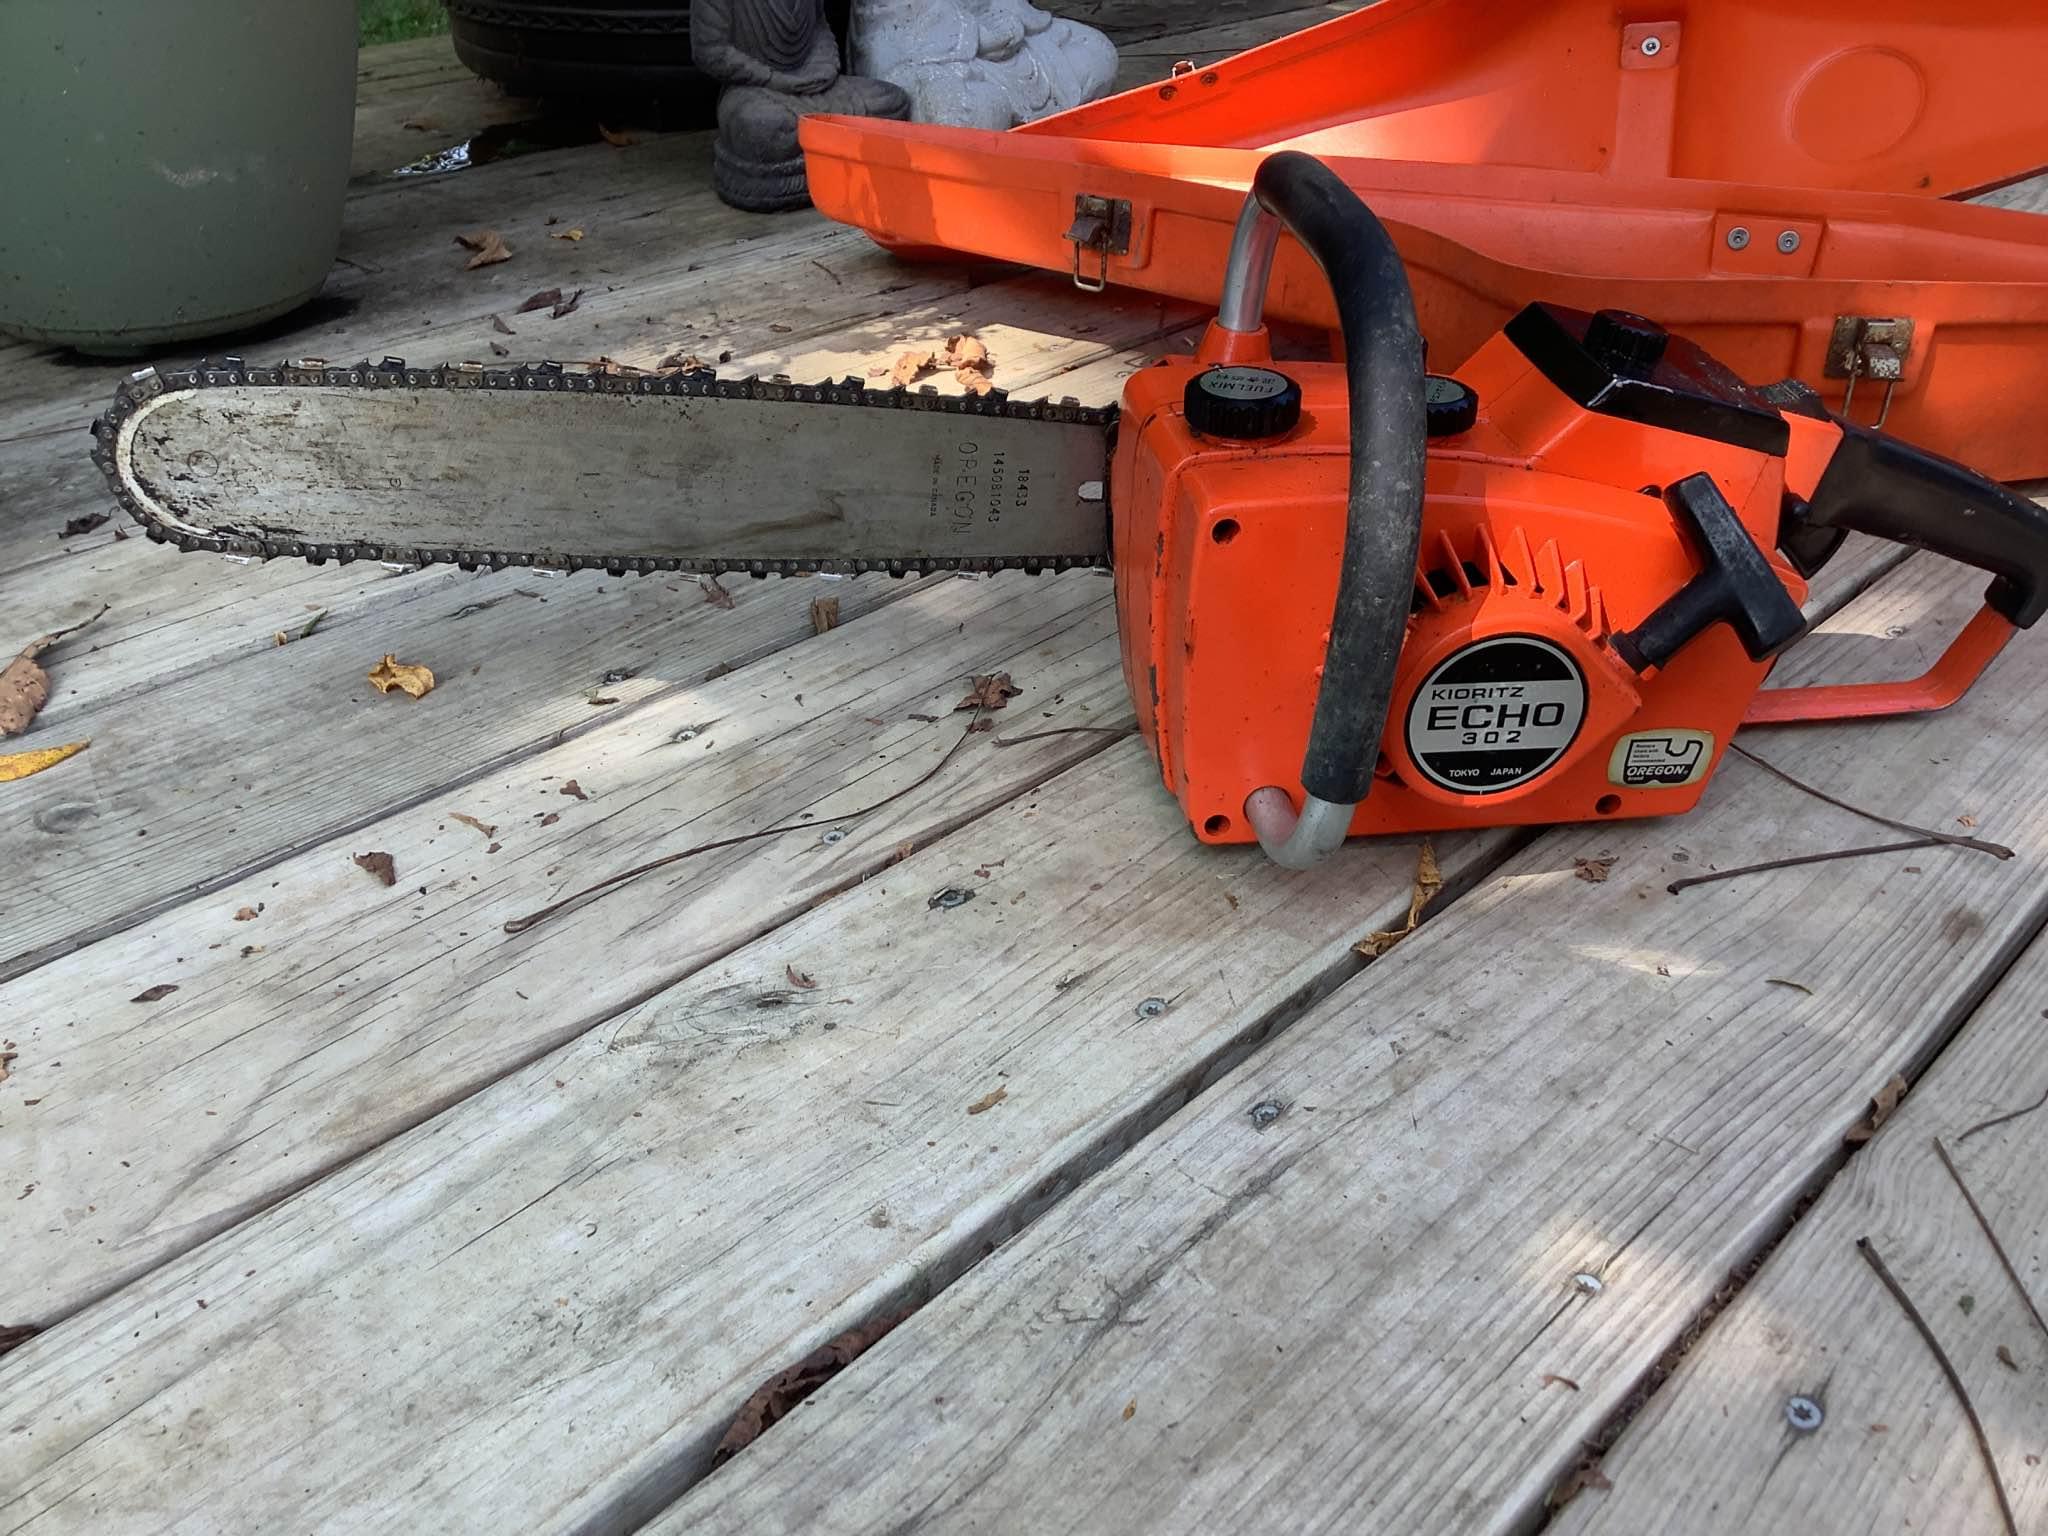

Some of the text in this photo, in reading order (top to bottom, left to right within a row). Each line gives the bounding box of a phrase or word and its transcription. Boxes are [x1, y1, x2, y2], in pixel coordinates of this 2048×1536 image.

[952, 442, 978, 535] OREGON
[1016, 470, 1030, 507] 18433
[1431, 686, 1525, 701] KIORITZ
[1426, 702, 1565, 731] ECHO
[1461, 730, 1521, 745] 302
[1449, 766, 1522, 778] TOKYO JAPAN
[1626, 765, 1685, 776] OREGON
